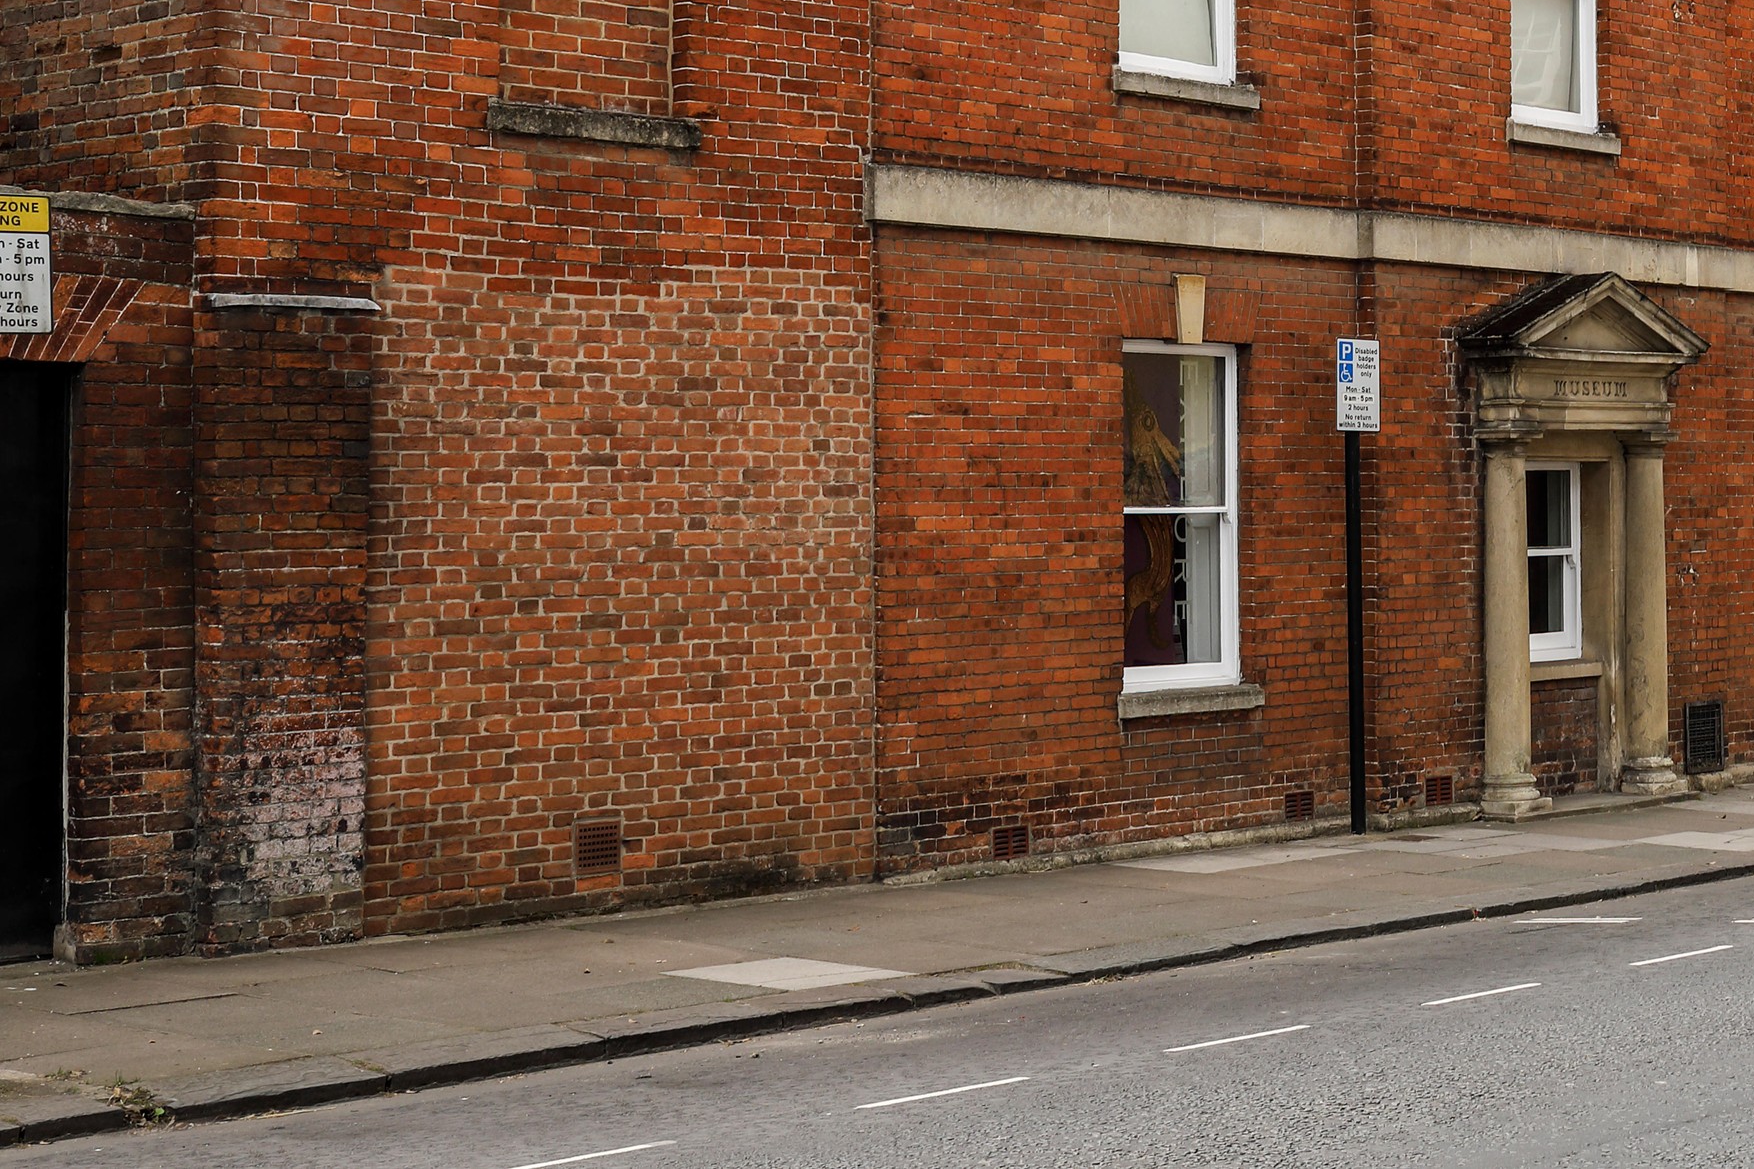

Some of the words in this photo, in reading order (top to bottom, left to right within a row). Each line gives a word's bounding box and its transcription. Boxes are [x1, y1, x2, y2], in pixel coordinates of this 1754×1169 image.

[0, 201, 40, 213] ZONE
[17, 238, 40, 249] Sat
[7, 302, 39, 313] Zone
[0, 316, 38, 327] hours
[1355, 347, 1378, 355] Disabled
[1358, 355, 1374, 363] badge
[1356, 362, 1376, 370] holders
[1360, 370, 1372, 378] only
[1553, 379, 1628, 397] MUSEUM
[1173, 360, 1199, 626] ELORE
